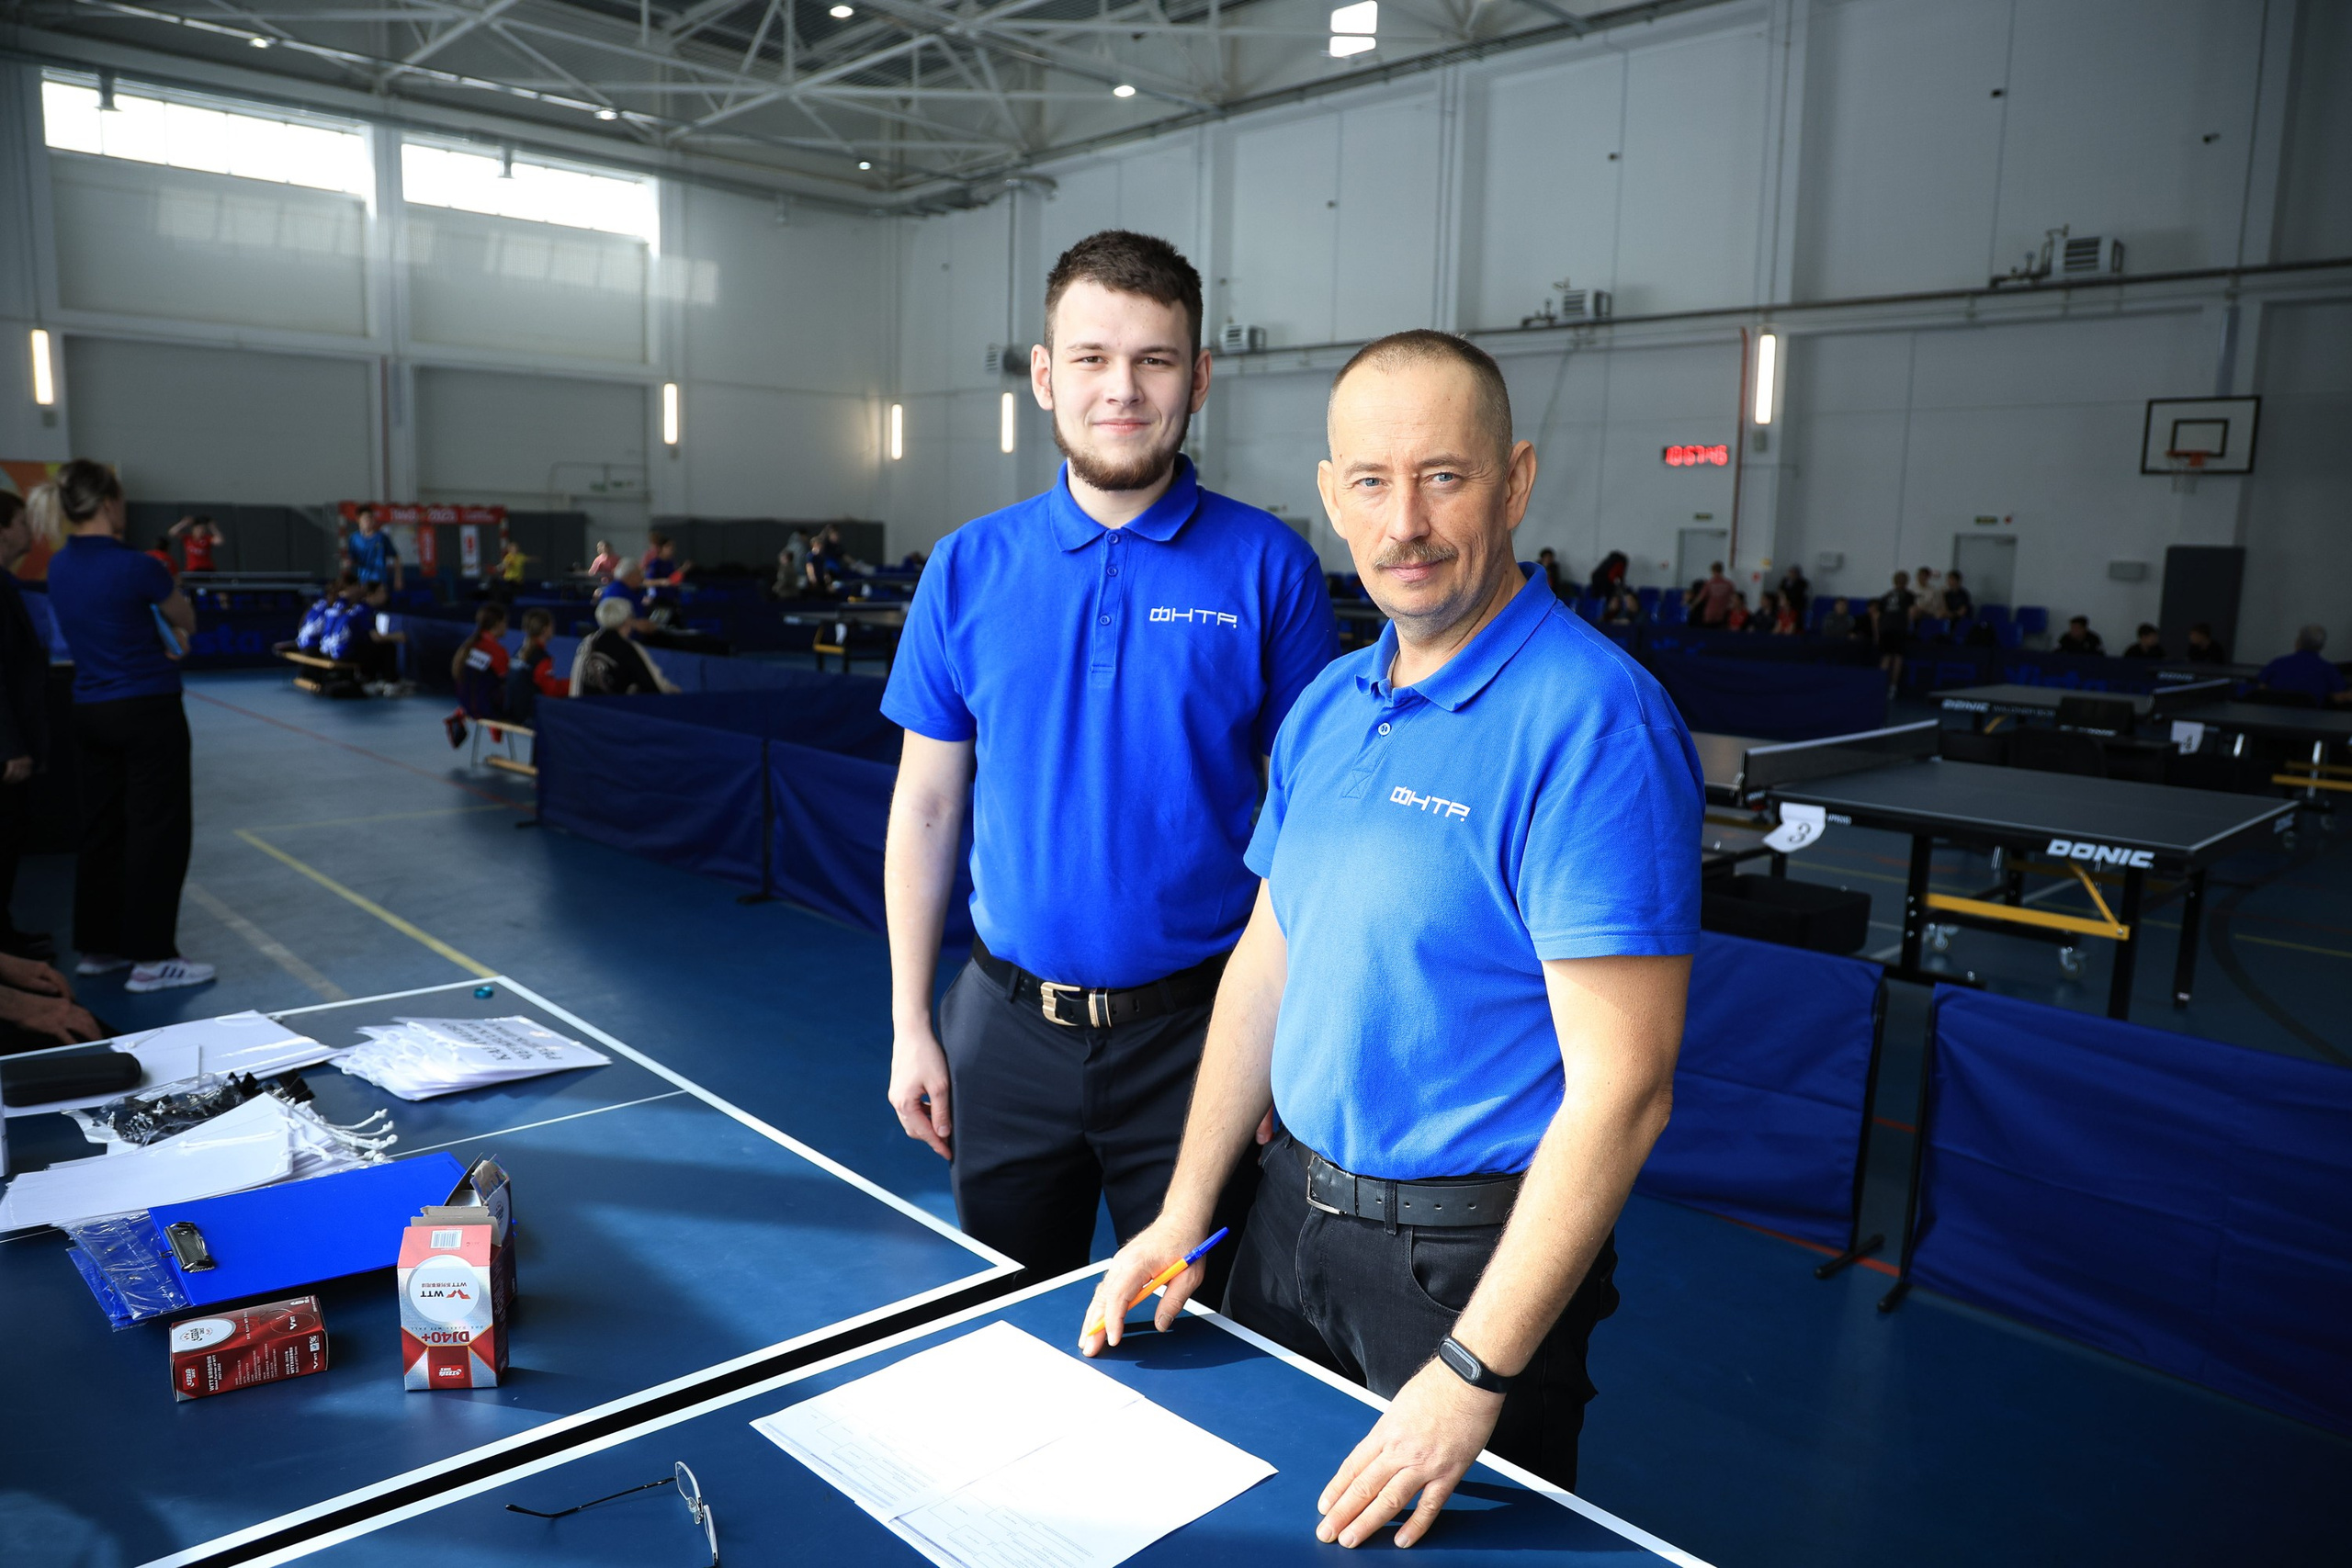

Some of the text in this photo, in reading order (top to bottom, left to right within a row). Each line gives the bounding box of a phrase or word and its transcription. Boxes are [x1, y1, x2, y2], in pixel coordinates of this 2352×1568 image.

[1788, 821, 1813, 843] 3
[2045, 838, 2155, 868] DONIC
[421, 1331, 469, 1343] DJ40+
